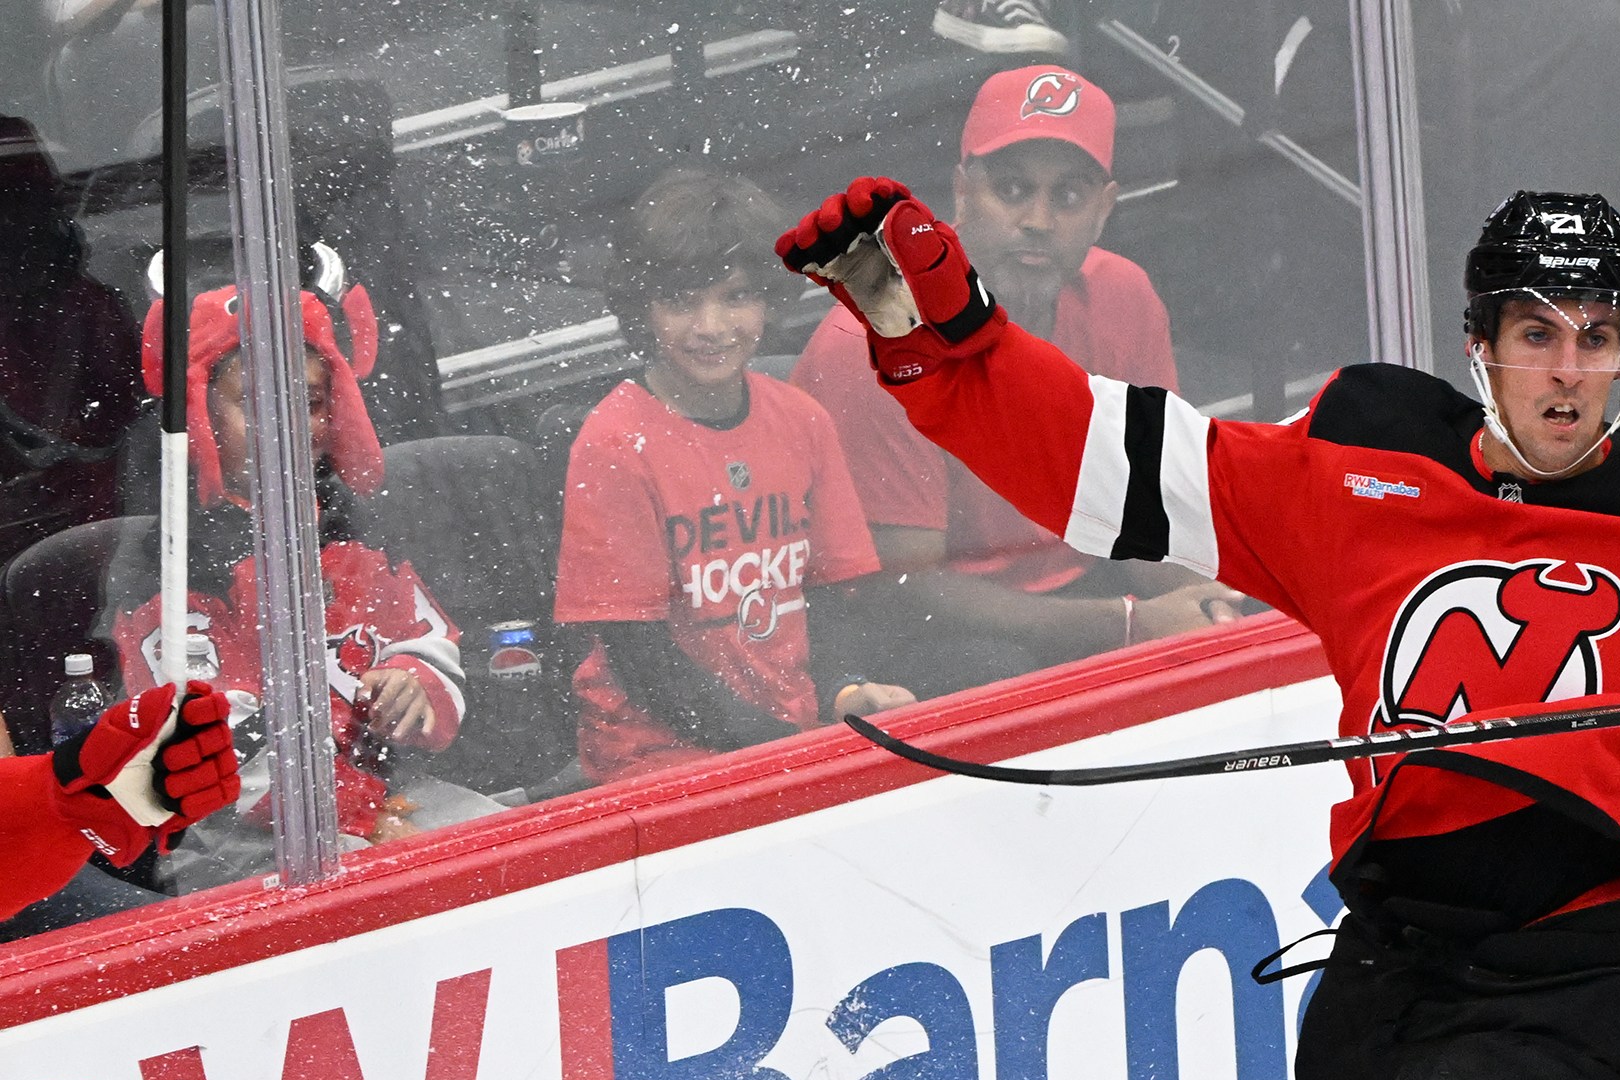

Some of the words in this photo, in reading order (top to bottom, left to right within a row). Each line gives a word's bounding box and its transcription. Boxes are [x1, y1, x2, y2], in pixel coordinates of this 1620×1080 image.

[1541, 211, 1586, 235] 21
[1344, 474, 1421, 498] RWJBarnabas
[682, 539, 811, 608] HOCKE
[1224, 755, 1280, 772] BAUER
